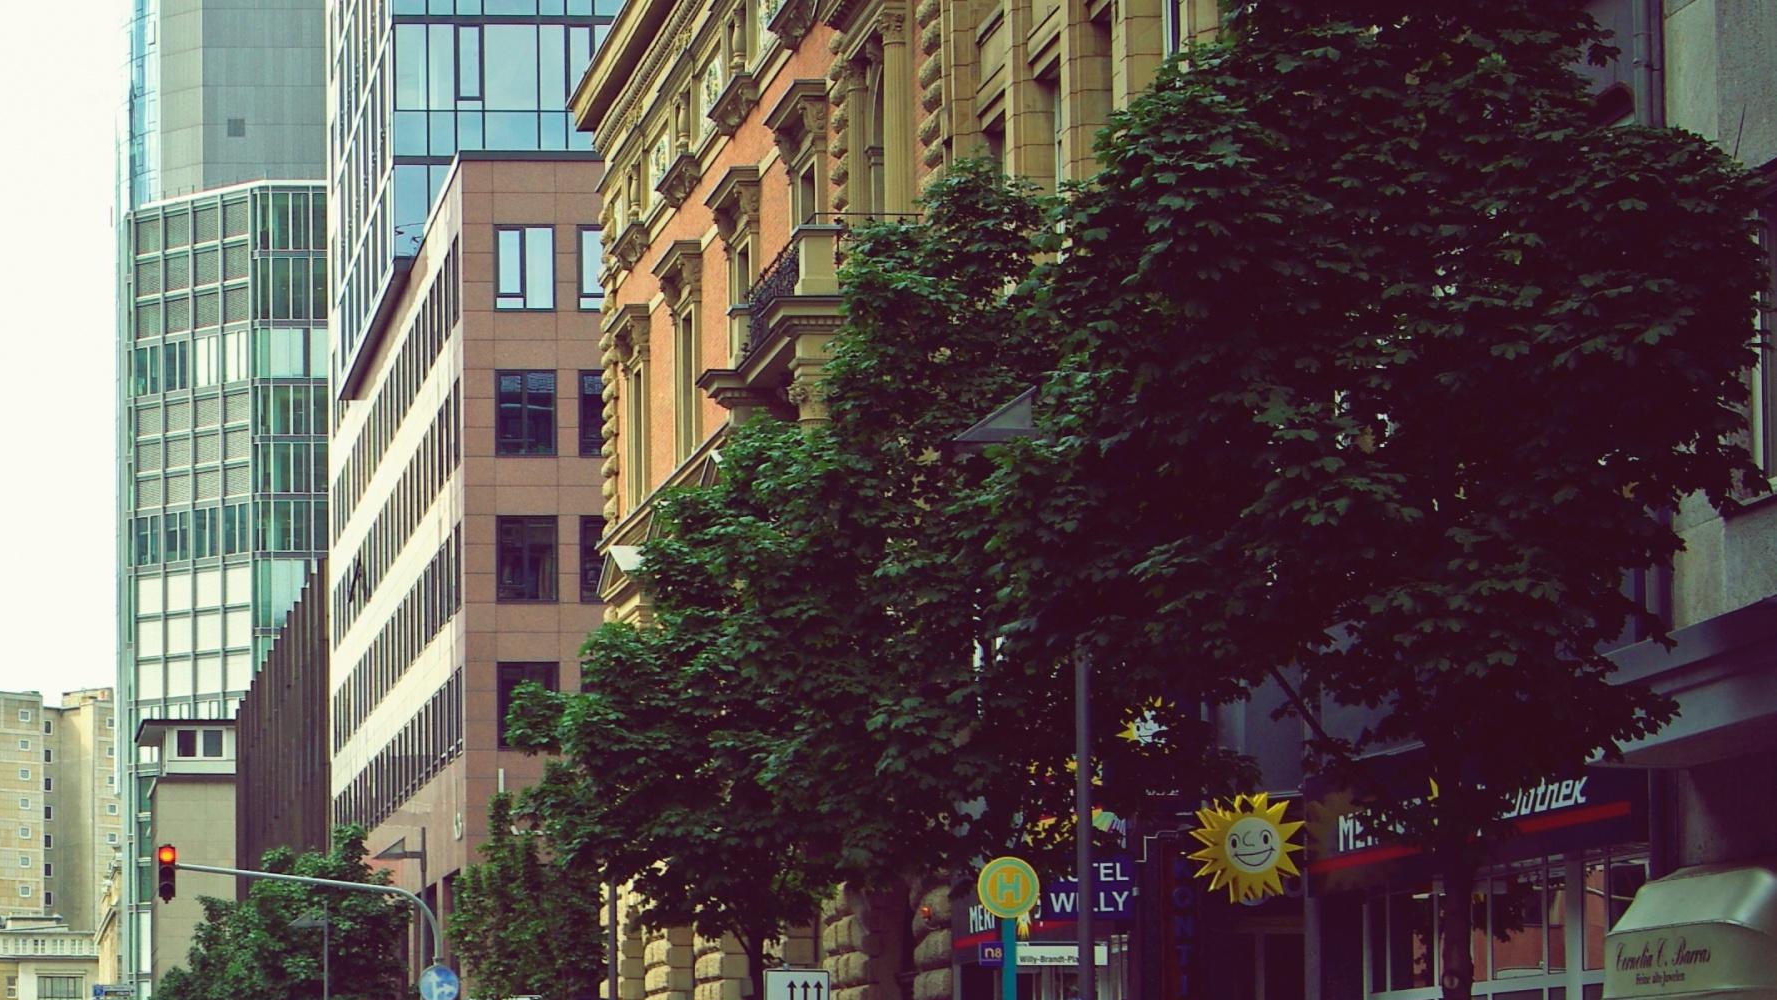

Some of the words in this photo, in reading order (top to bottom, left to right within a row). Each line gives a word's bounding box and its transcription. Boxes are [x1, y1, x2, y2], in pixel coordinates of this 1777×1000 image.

[997, 873, 1022, 903] H
[984, 947, 1003, 959] n8
[1616, 942, 1654, 971] Cornelia
[1672, 936, 1711, 966] Barras
